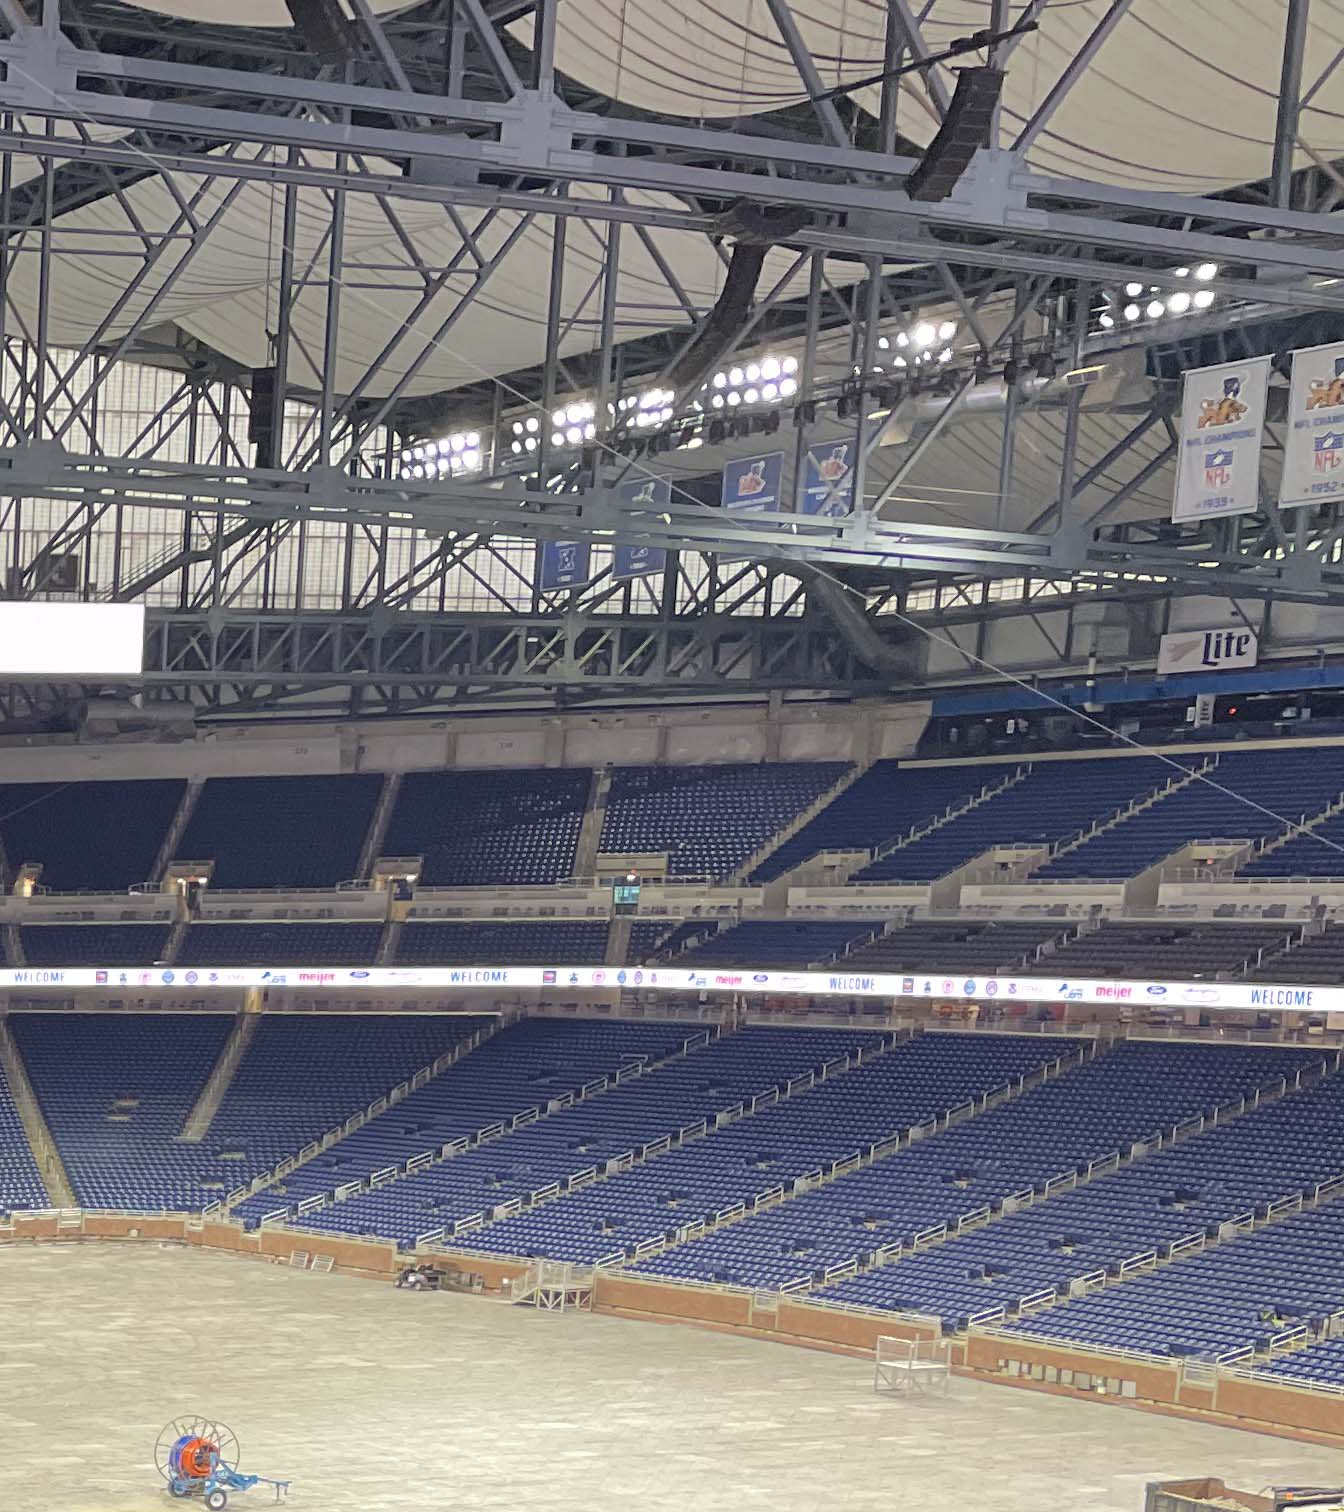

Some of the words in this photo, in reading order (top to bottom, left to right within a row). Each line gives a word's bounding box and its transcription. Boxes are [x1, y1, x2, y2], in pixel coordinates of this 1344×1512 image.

[1315, 450, 1341, 473] NFL
[1205, 467, 1231, 489] NFL
[1201, 632, 1250, 667] Lite
[14, 972, 64, 982] WELCOME
[299, 973, 335, 985] meijer
[450, 971, 508, 982] WELCOME
[715, 974, 743, 986] meijer
[829, 977, 875, 990] WELCOME
[1095, 985, 1132, 999] meijer
[1251, 989, 1313, 1005] WELCOME
